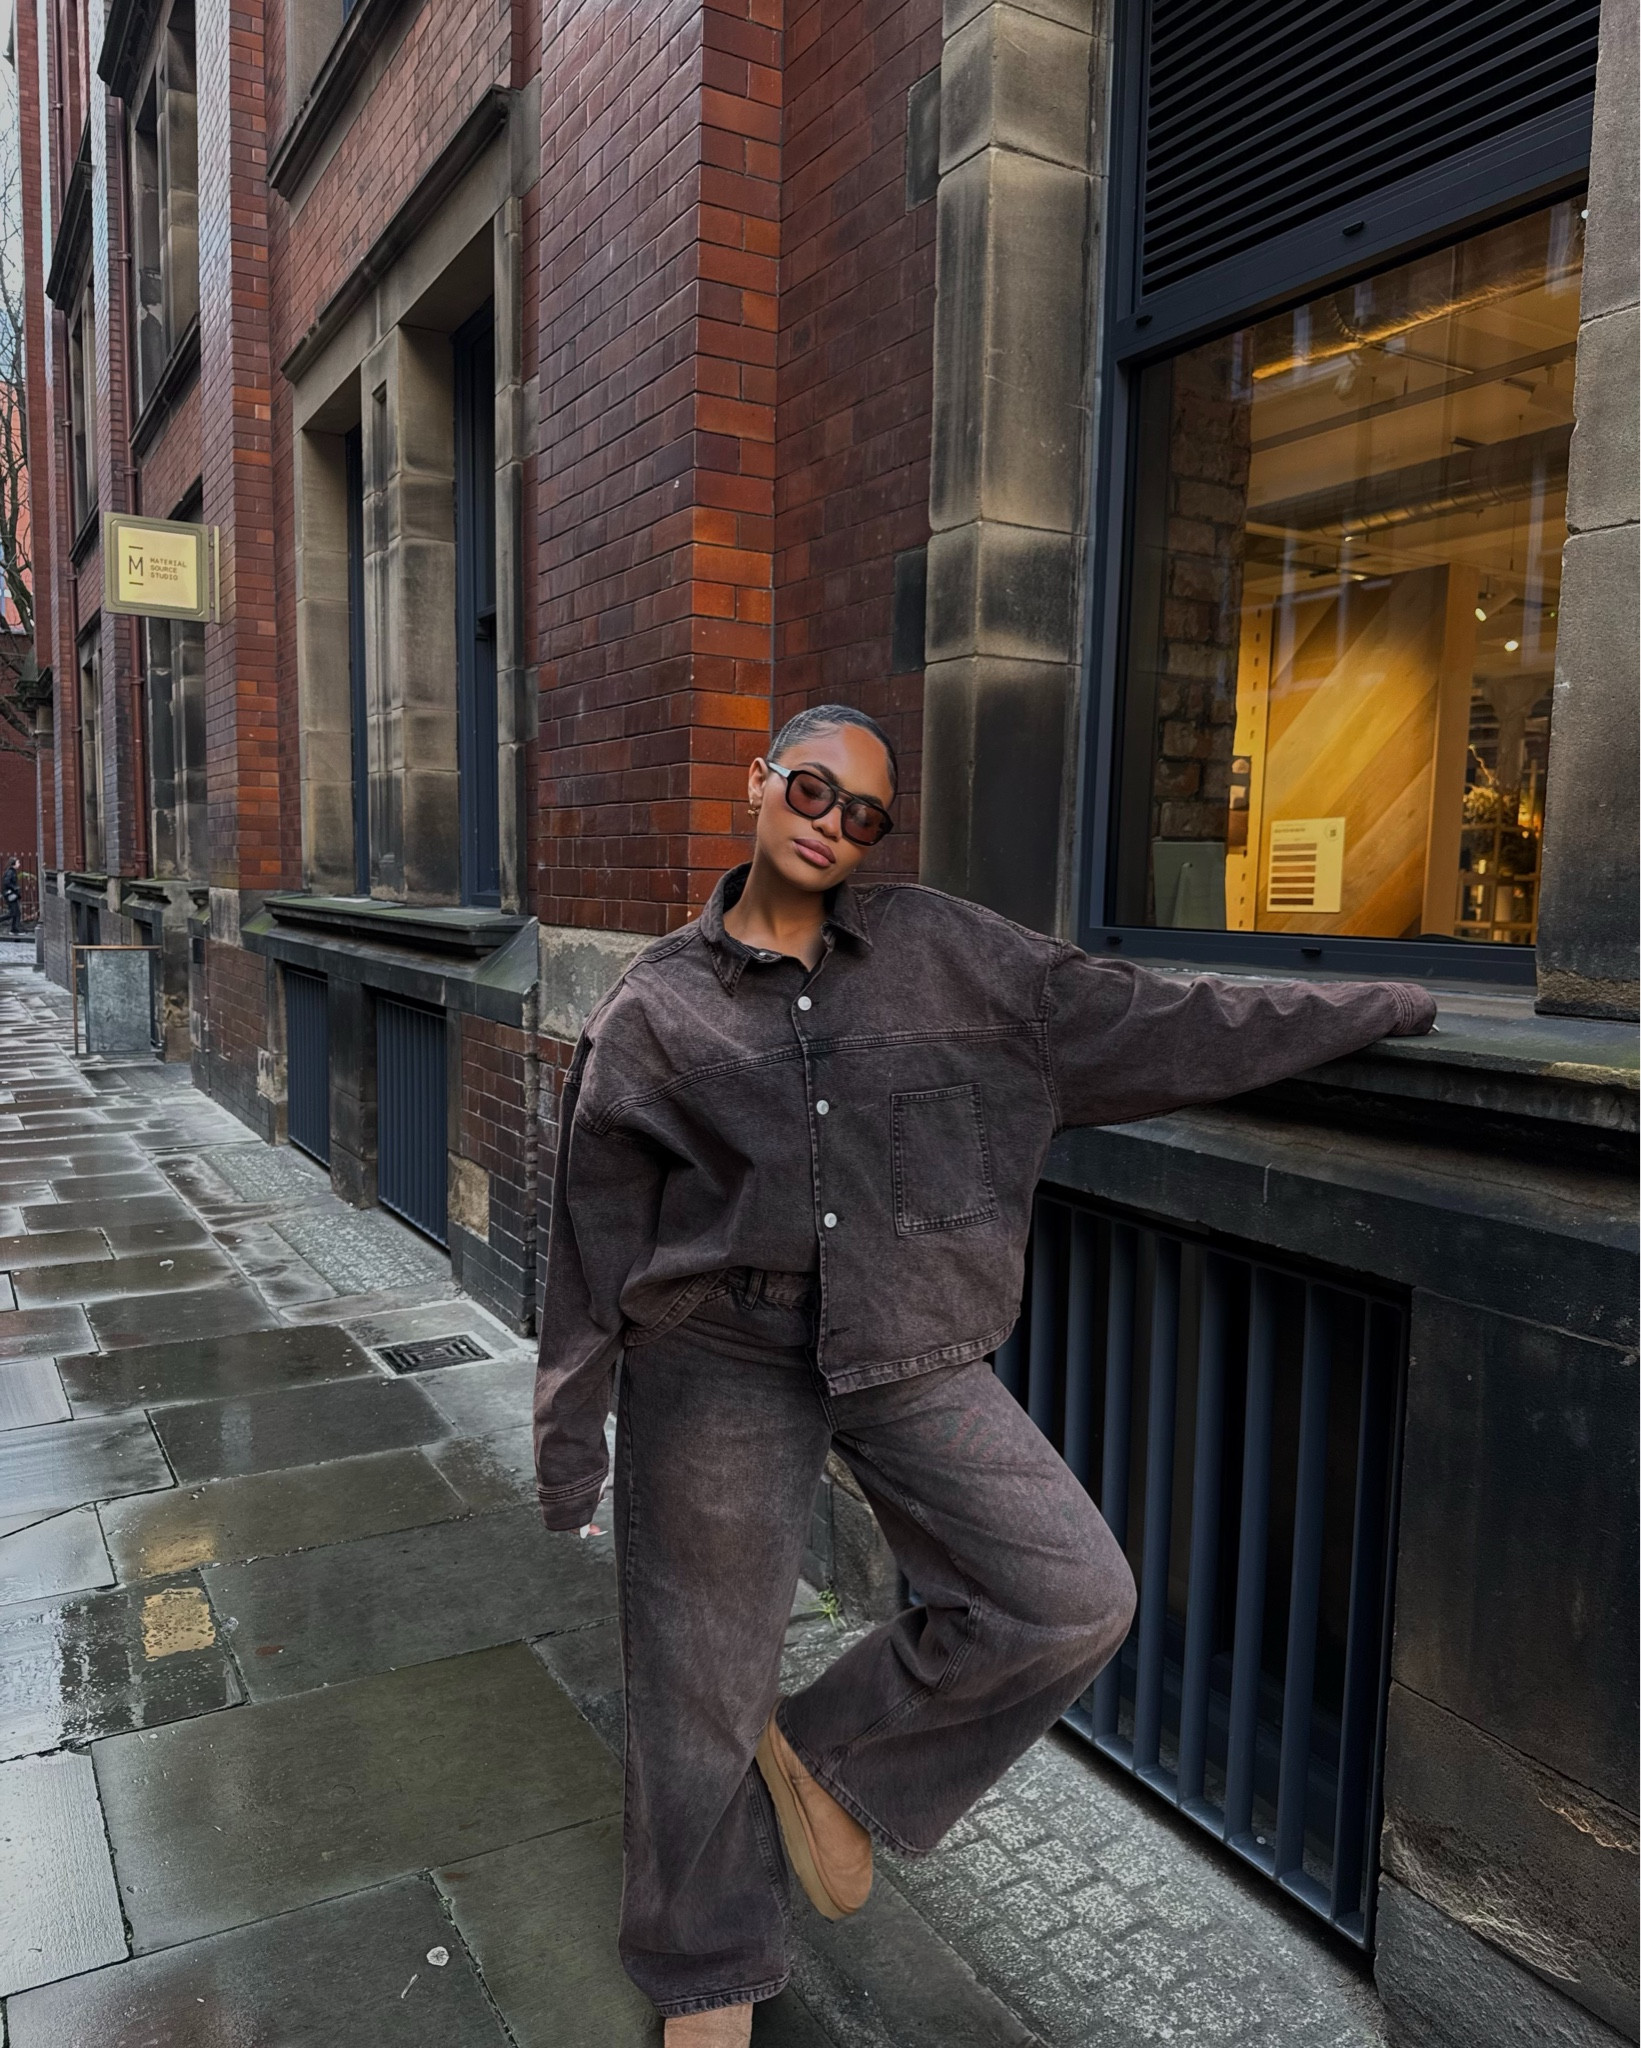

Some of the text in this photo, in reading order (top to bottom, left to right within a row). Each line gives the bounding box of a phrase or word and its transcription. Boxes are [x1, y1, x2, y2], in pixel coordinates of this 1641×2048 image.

[128, 555, 144, 577] M
[150, 557, 187, 568] MATERIAL
[150, 564, 178, 573] SOURCE
[150, 572, 178, 581] STUDIO
